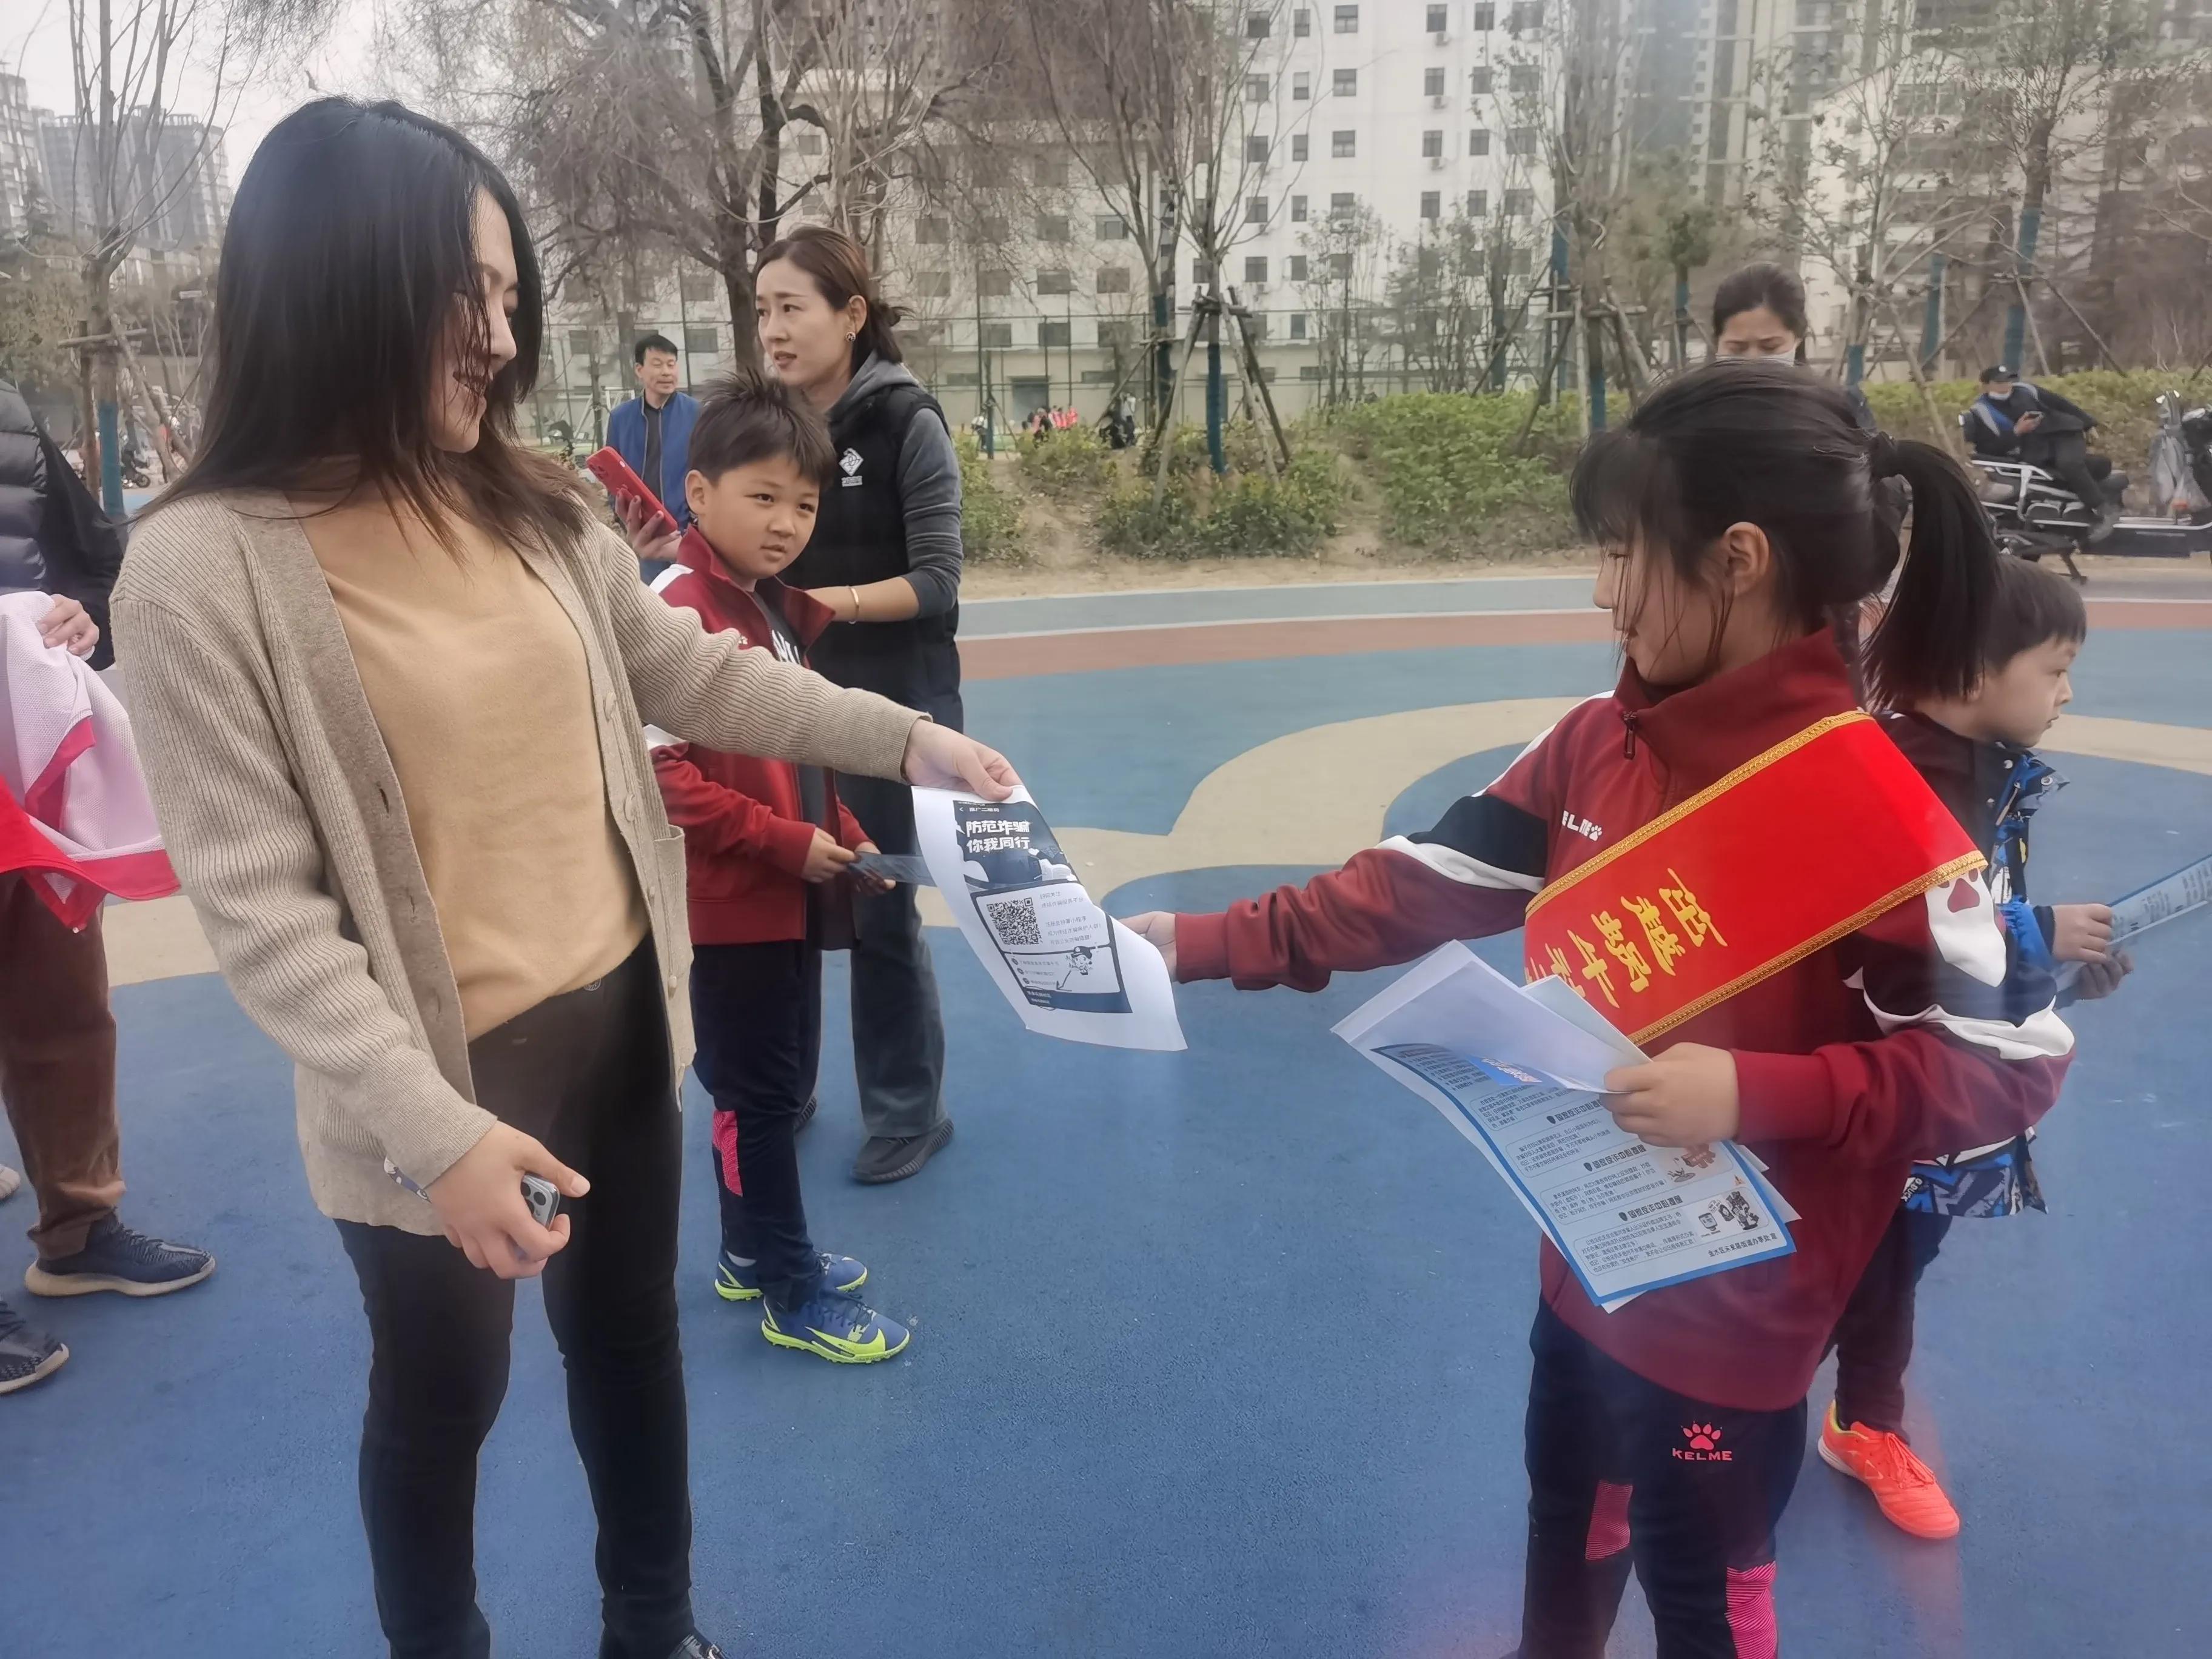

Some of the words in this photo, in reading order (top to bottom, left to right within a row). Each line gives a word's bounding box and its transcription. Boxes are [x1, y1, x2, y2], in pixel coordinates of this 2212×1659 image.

[966, 820, 1030, 837] 防范诈骗
[966, 837, 1030, 853] 你我同行
[1672, 1448, 1732, 1461] KELME
